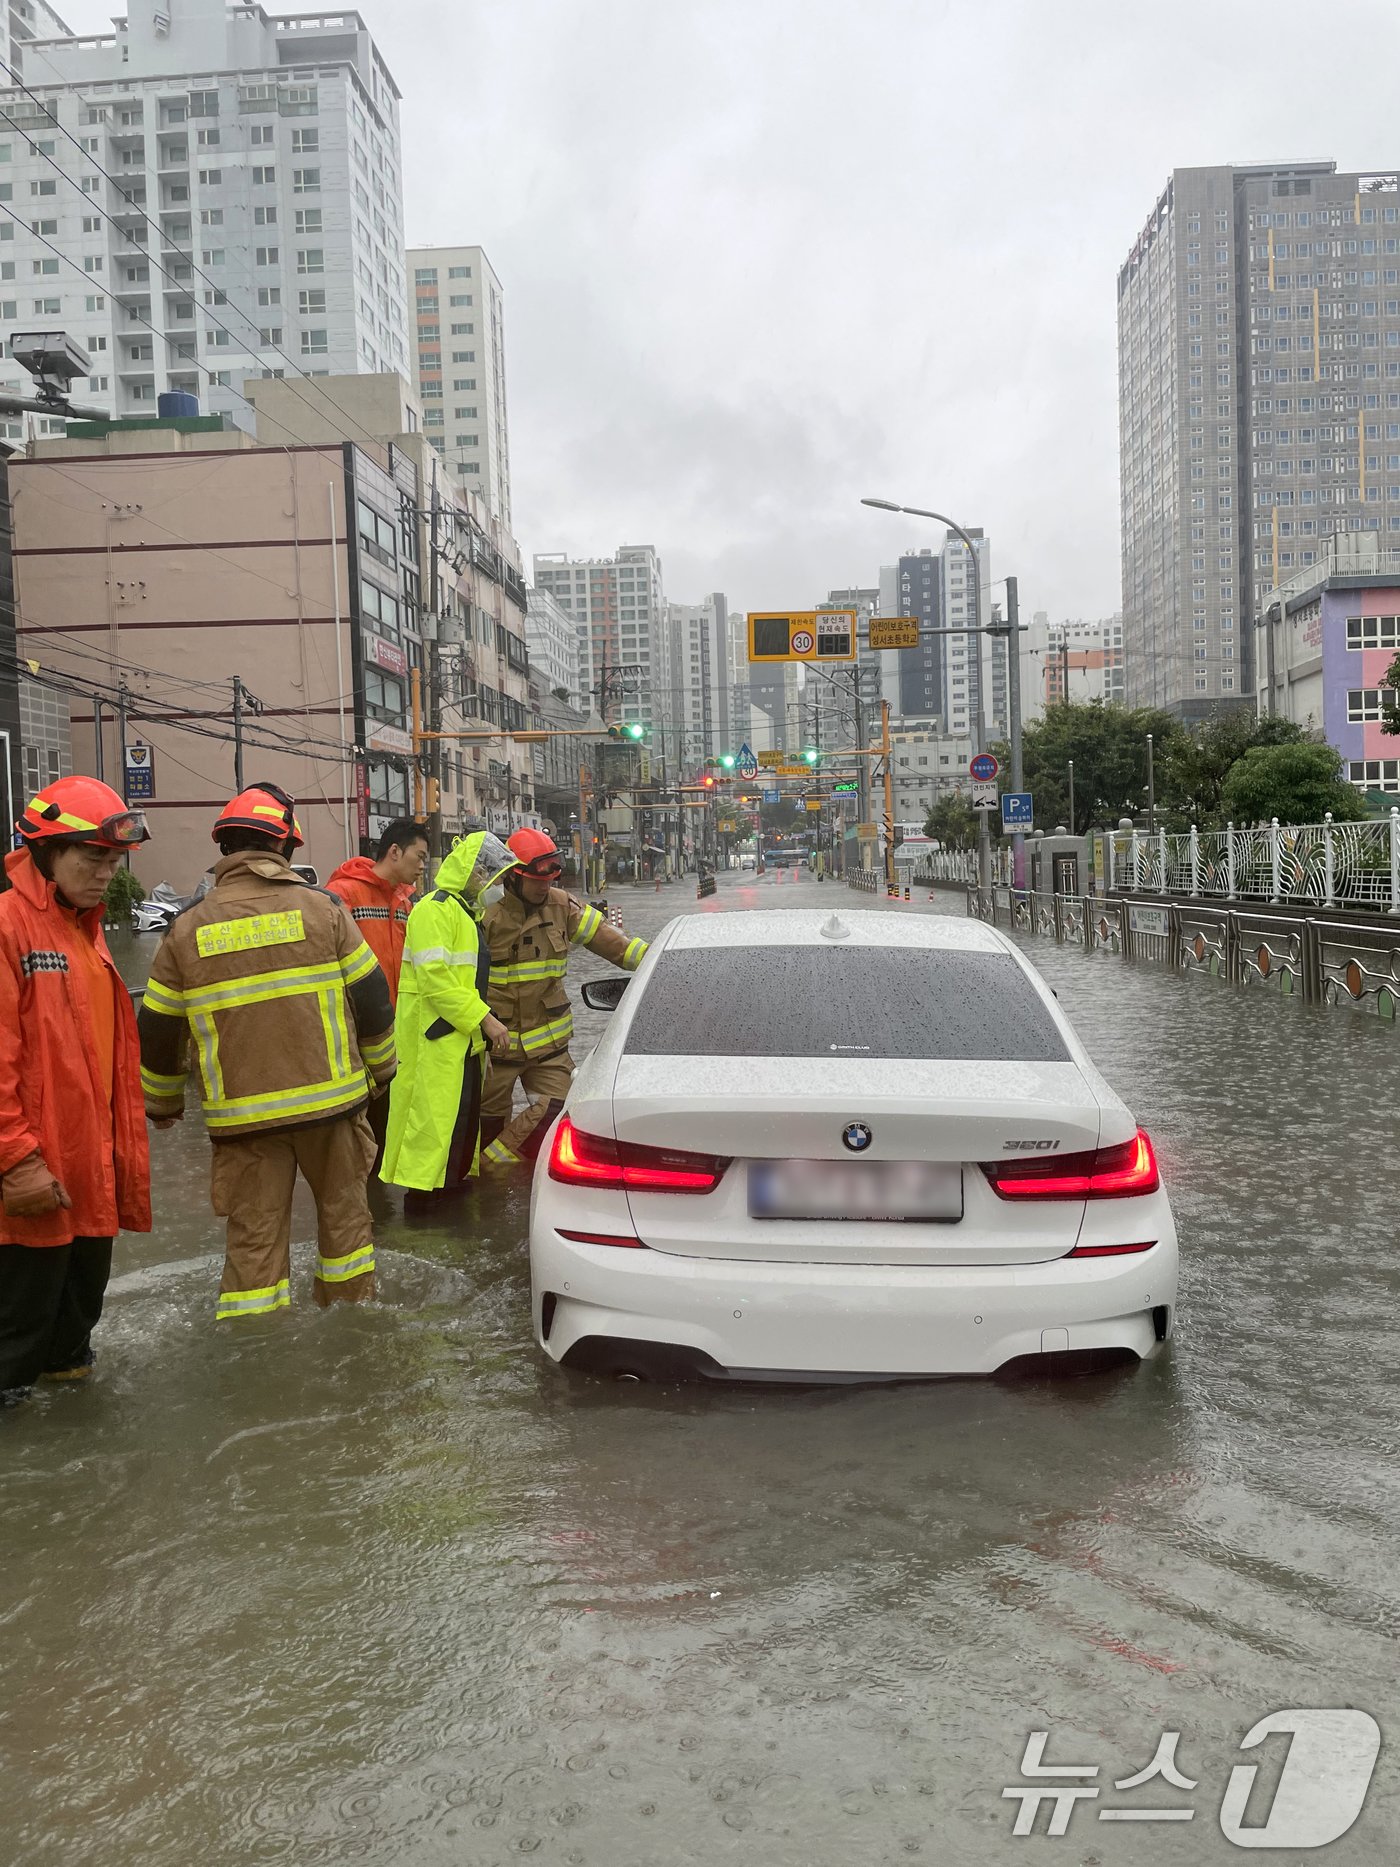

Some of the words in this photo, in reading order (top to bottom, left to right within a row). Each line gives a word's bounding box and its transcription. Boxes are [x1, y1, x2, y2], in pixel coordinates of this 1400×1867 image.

[790, 618, 814, 626] 제한속도
[822, 615, 845, 624] 당신의
[818, 625, 849, 633] 현재속도
[870, 620, 917, 632] 어린이보호구역
[795, 636, 810, 649] 30
[871, 633, 917, 645] 성서초등학교
[744, 767, 754, 776] 30
[1009, 798, 1020, 813] P
[204, 927, 299, 952] 범일119안전센터
[845, 1123, 869, 1134] BMW
